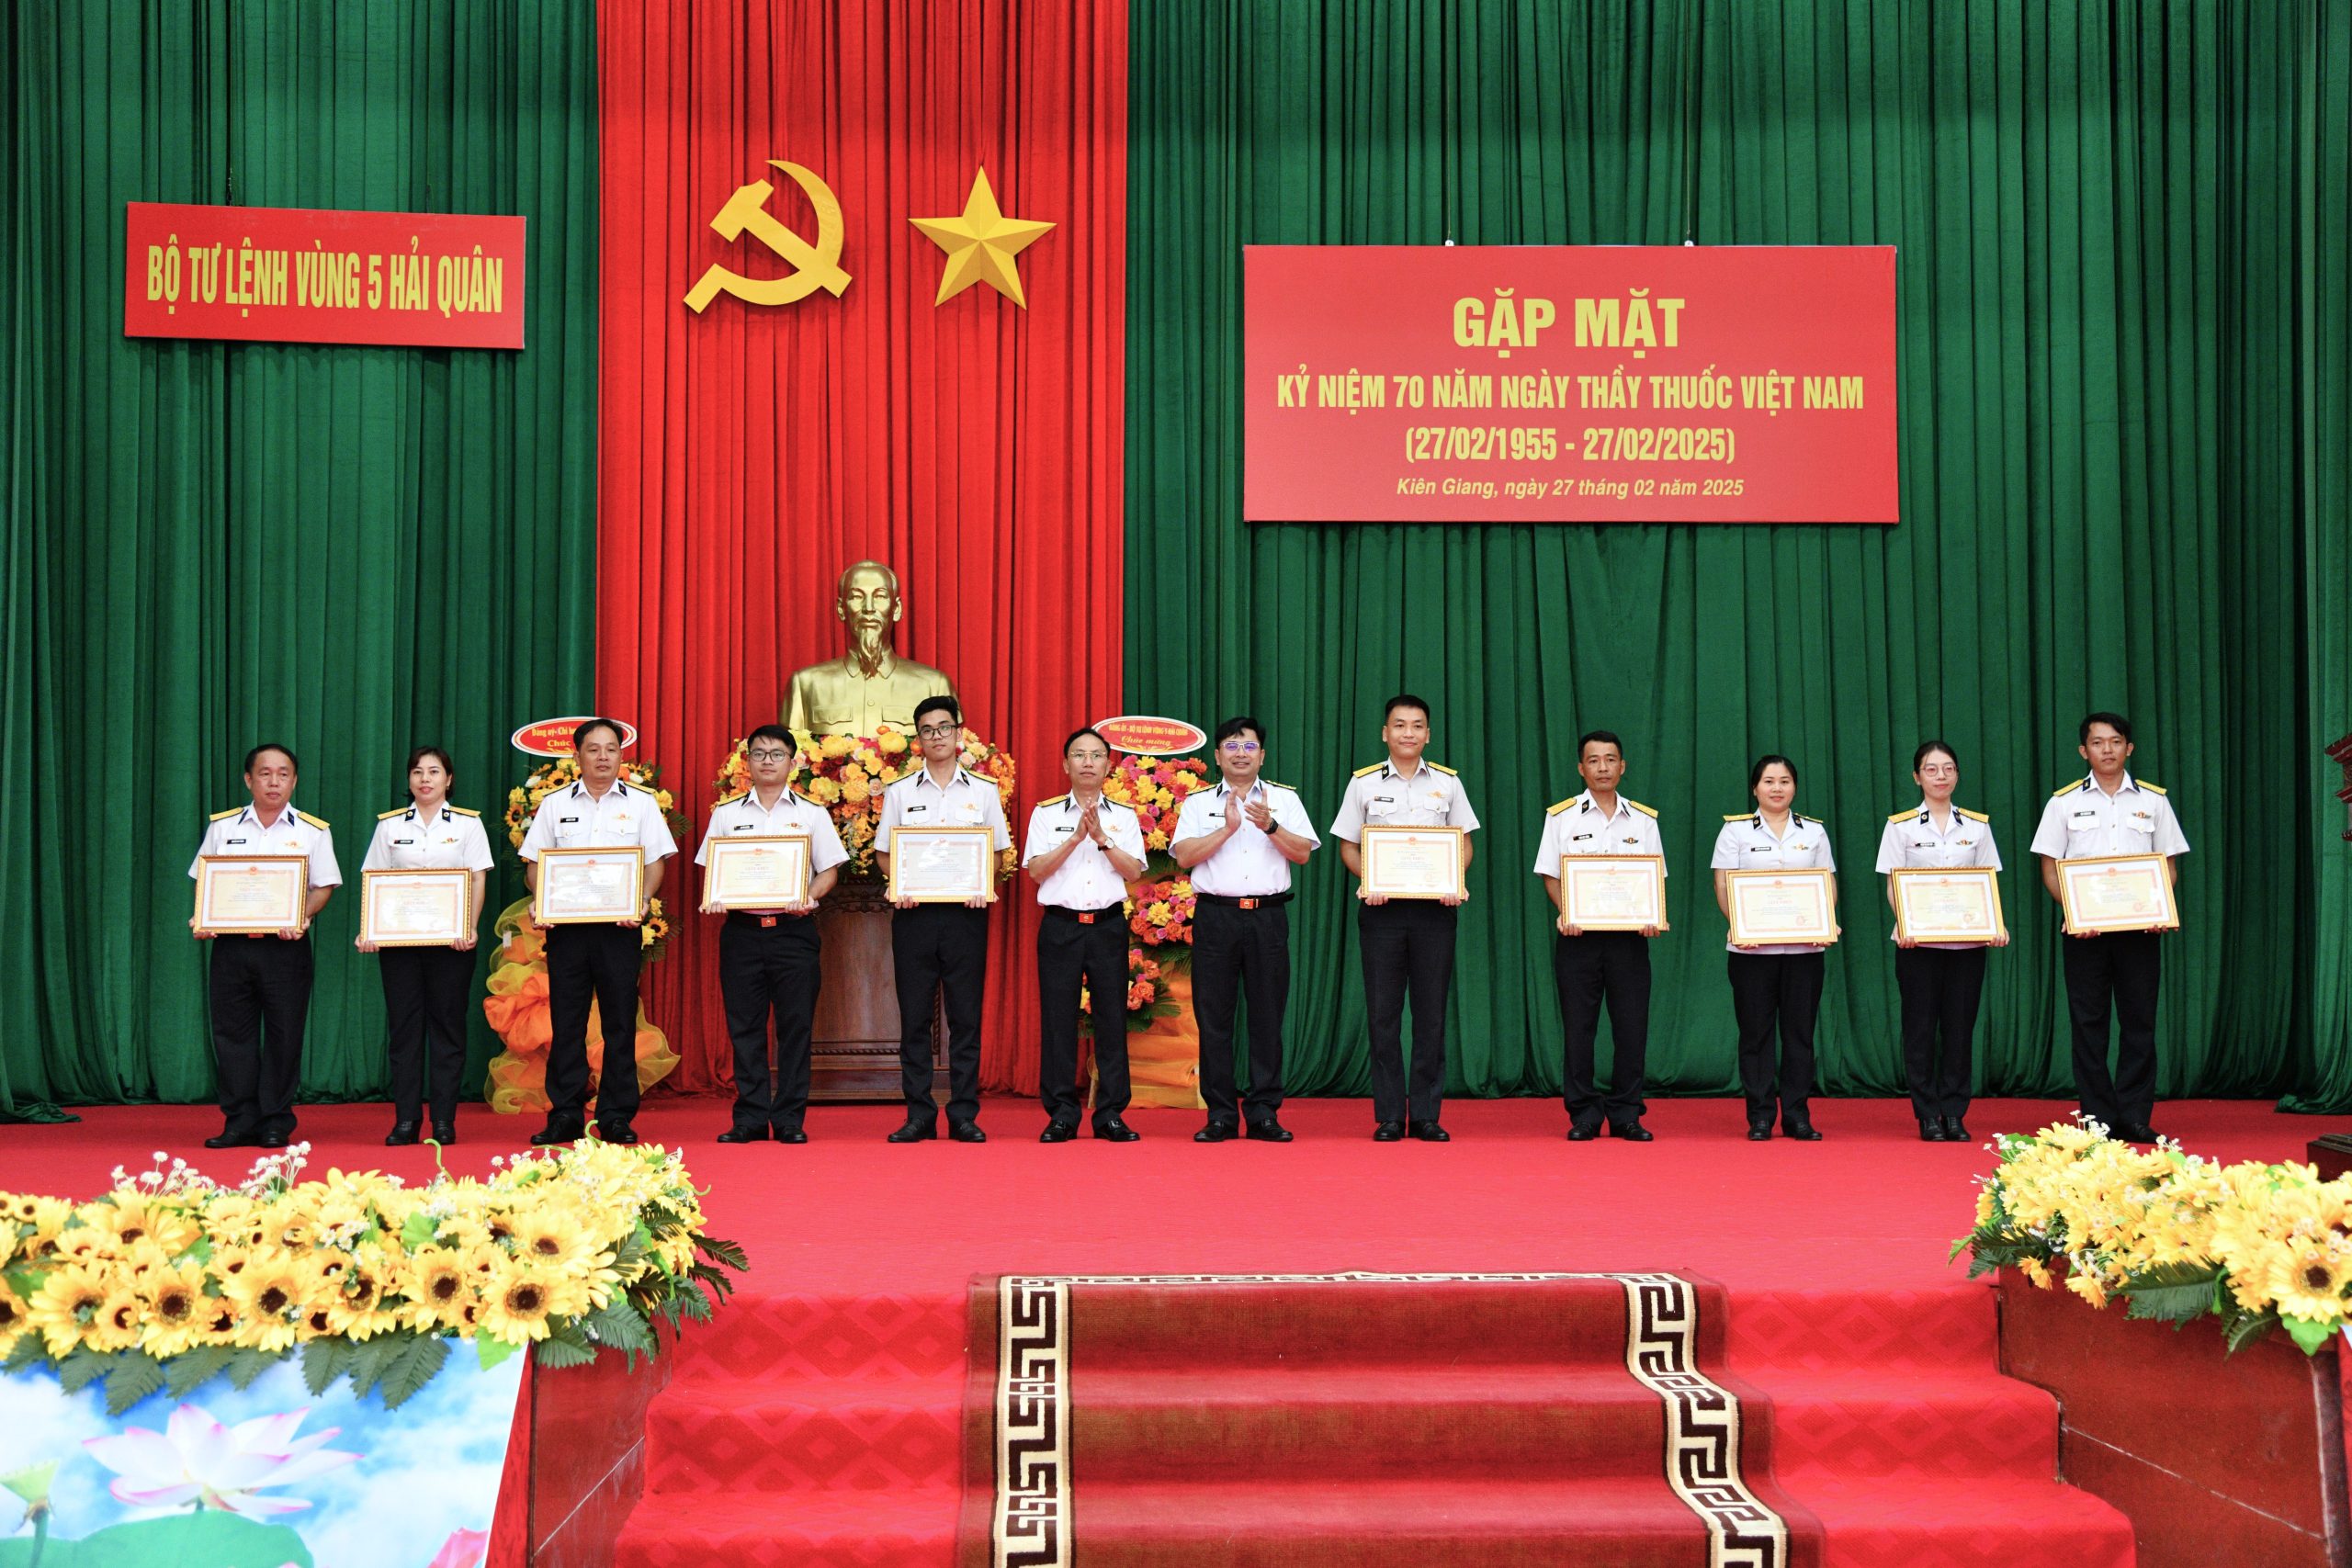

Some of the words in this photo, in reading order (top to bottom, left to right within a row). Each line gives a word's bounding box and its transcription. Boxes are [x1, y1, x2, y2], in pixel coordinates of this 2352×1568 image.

[147, 233, 181, 315] BỘ
[188, 242, 221, 304] TƯ
[225, 237, 288, 318] LỆNH
[295, 239, 361, 309] VÙNG
[367, 254, 382, 310] 5
[389, 235, 430, 310] HẢI
[436, 244, 503, 319] QUÂN
[1453, 287, 1556, 359] GẶP
[1575, 288, 1686, 359] MẶT
[1277, 363, 1311, 408] KỶ
[1317, 367, 1385, 416] NIỆM
[1392, 375, 1425, 409] 70
[1432, 367, 1493, 409] NĂM
[1500, 367, 1570, 409] NGÀY
[1577, 364, 1642, 409] THẦY
[1648, 364, 1733, 410] THUỐC
[1740, 368, 1796, 417] VIỆT
[1803, 376, 1864, 410] NAM
[1406, 425, 1557, 464] (27/02/1955
[1565, 442, 1576, 450] -
[1582, 426, 1736, 465] 27/02/2025)
[1396, 477, 1437, 497] Kiên
[1442, 477, 1498, 500] Giang,
[1504, 478, 1549, 500] ngày
[1552, 479, 1575, 496] 27
[1577, 478, 1629, 501] tháng
[1634, 479, 1656, 496] 02
[1658, 479, 1698, 496] năm
[1702, 479, 1745, 496] 2025
